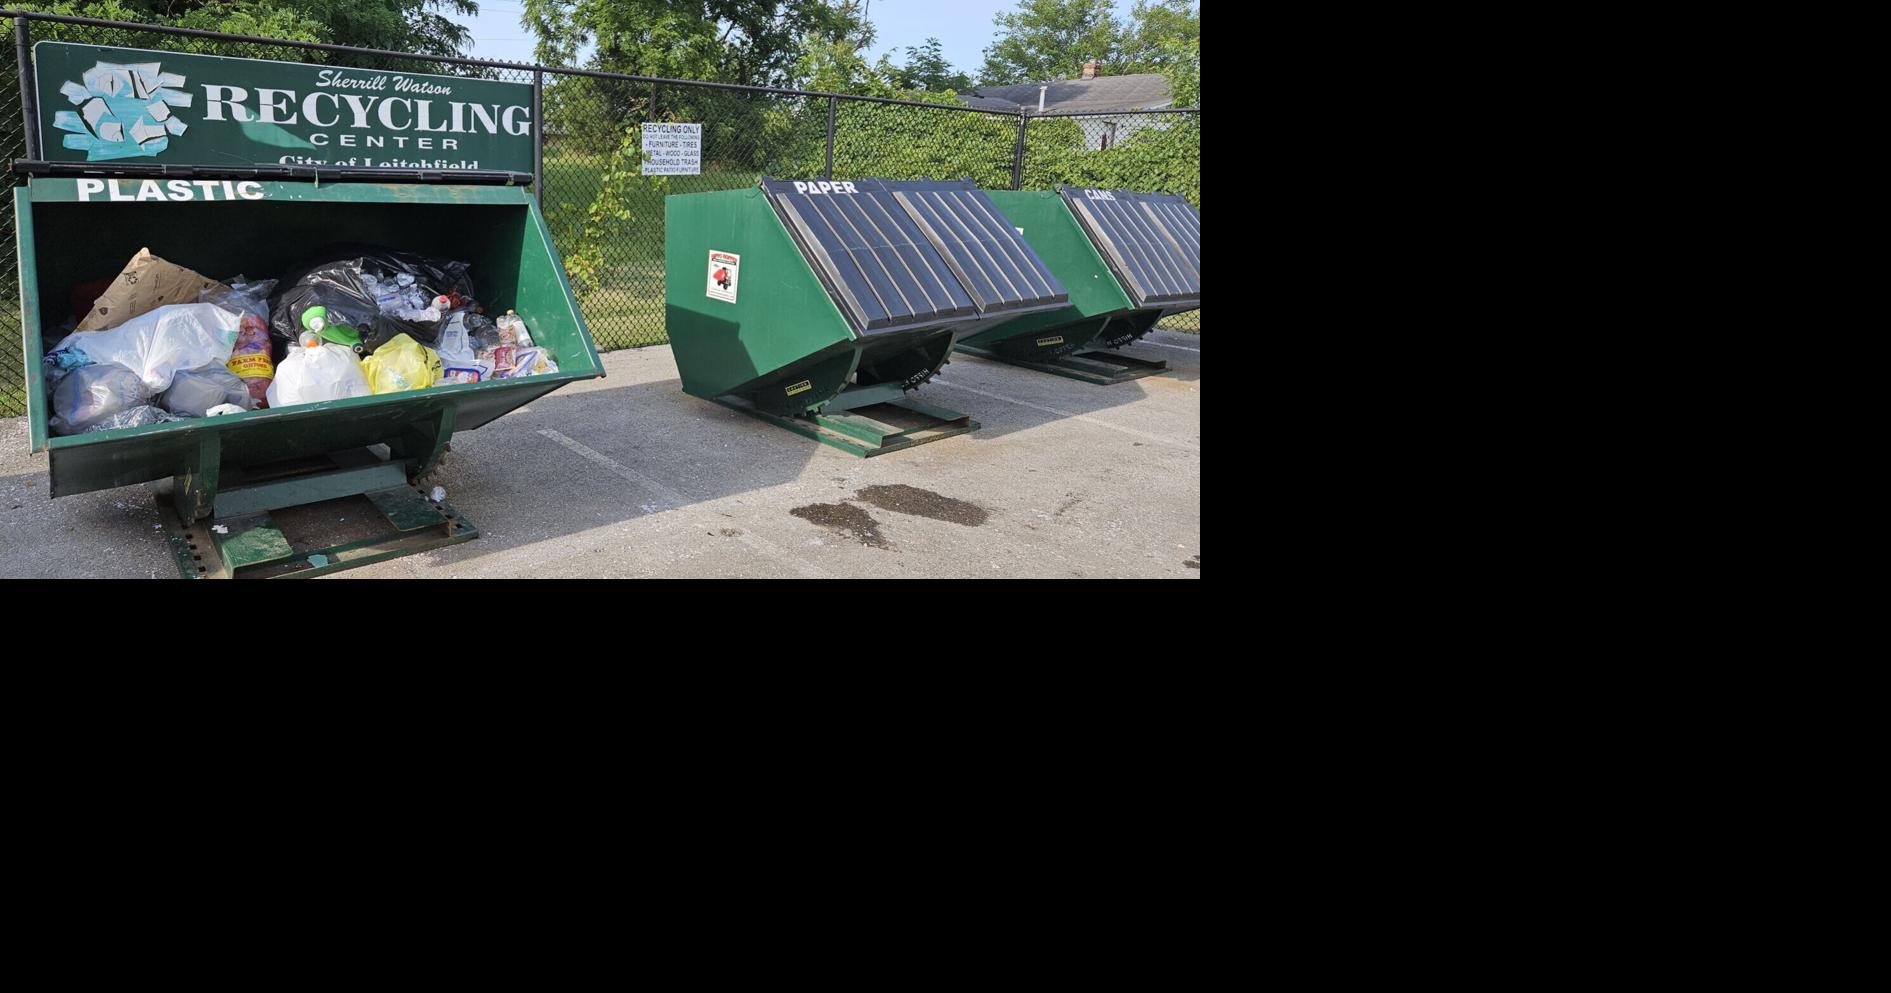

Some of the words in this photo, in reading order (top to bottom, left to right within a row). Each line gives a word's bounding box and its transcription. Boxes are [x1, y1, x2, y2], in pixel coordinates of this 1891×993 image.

[316, 69, 388, 91] Sherrill
[392, 75, 453, 95] Watson
[200, 83, 532, 136] RECYCLING
[643, 124, 682, 134] RECYCLING
[683, 125, 700, 134] ONLY
[309, 133, 458, 150] CENTER
[648, 140, 679, 148] FURNITURE
[76, 178, 265, 202] PLASTIC
[793, 181, 860, 195] PAPER
[1084, 189, 1116, 201] CANS
